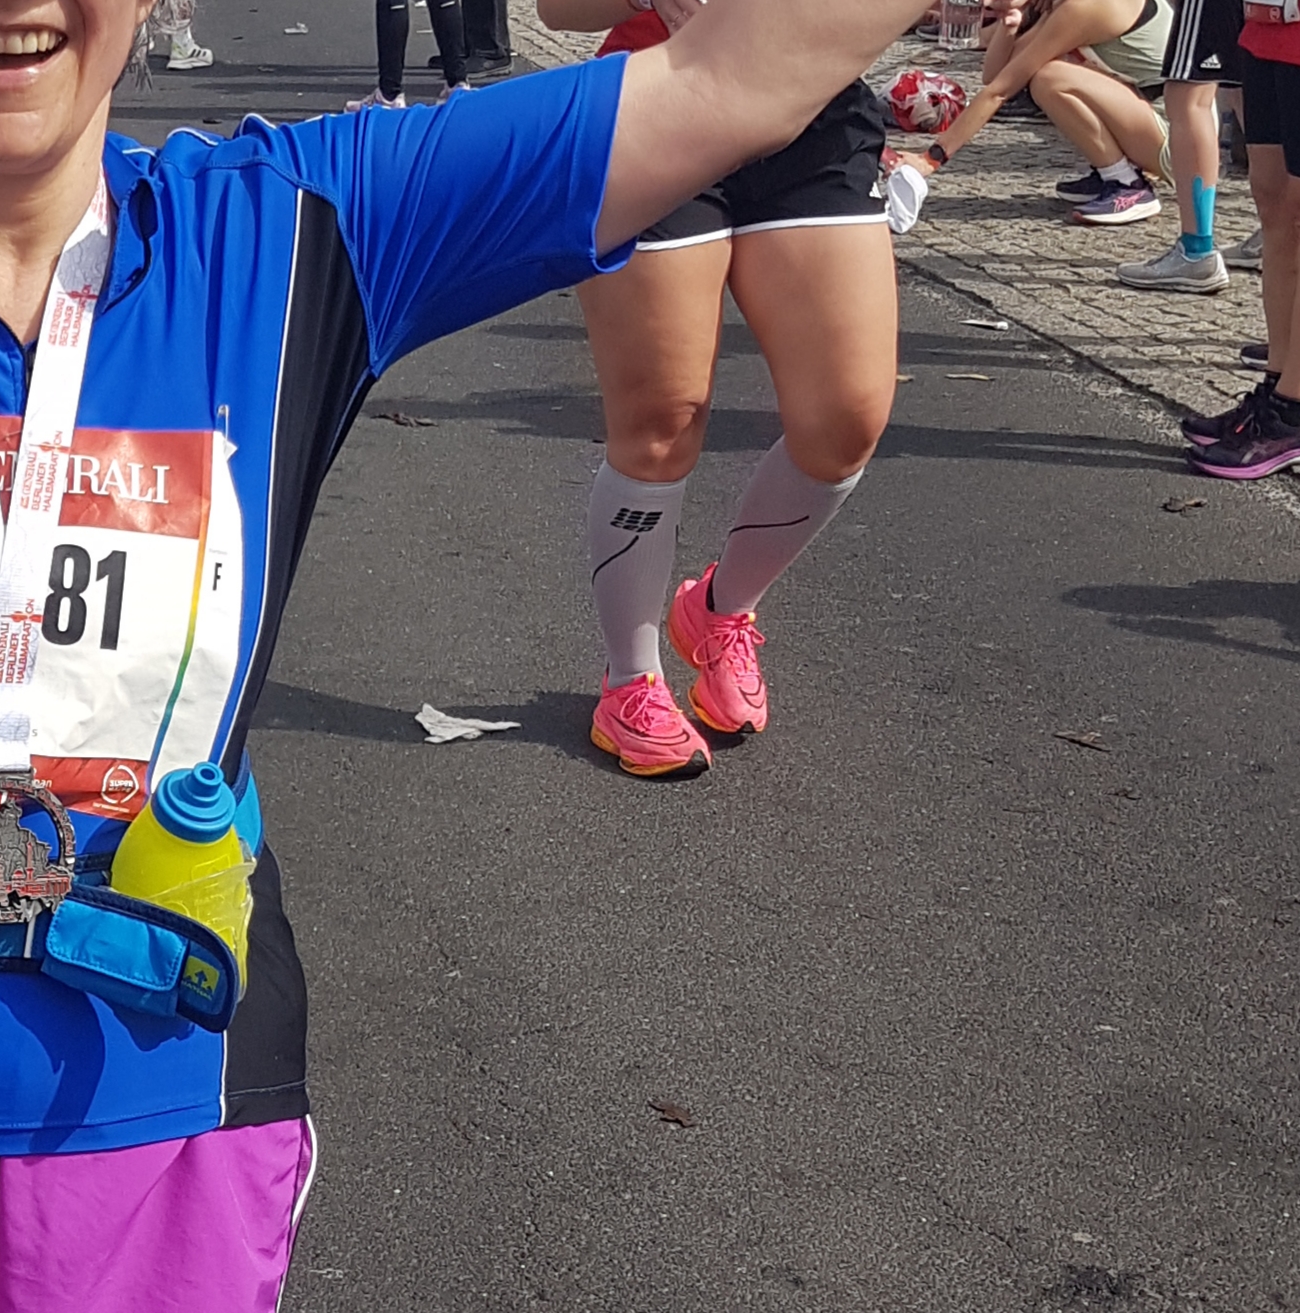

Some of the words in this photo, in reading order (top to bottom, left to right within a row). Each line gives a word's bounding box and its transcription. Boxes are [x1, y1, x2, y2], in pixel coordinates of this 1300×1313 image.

[31, 462, 46, 511] BERLINER
[212, 562, 223, 591] F
[5, 632, 20, 684] BERLINER
